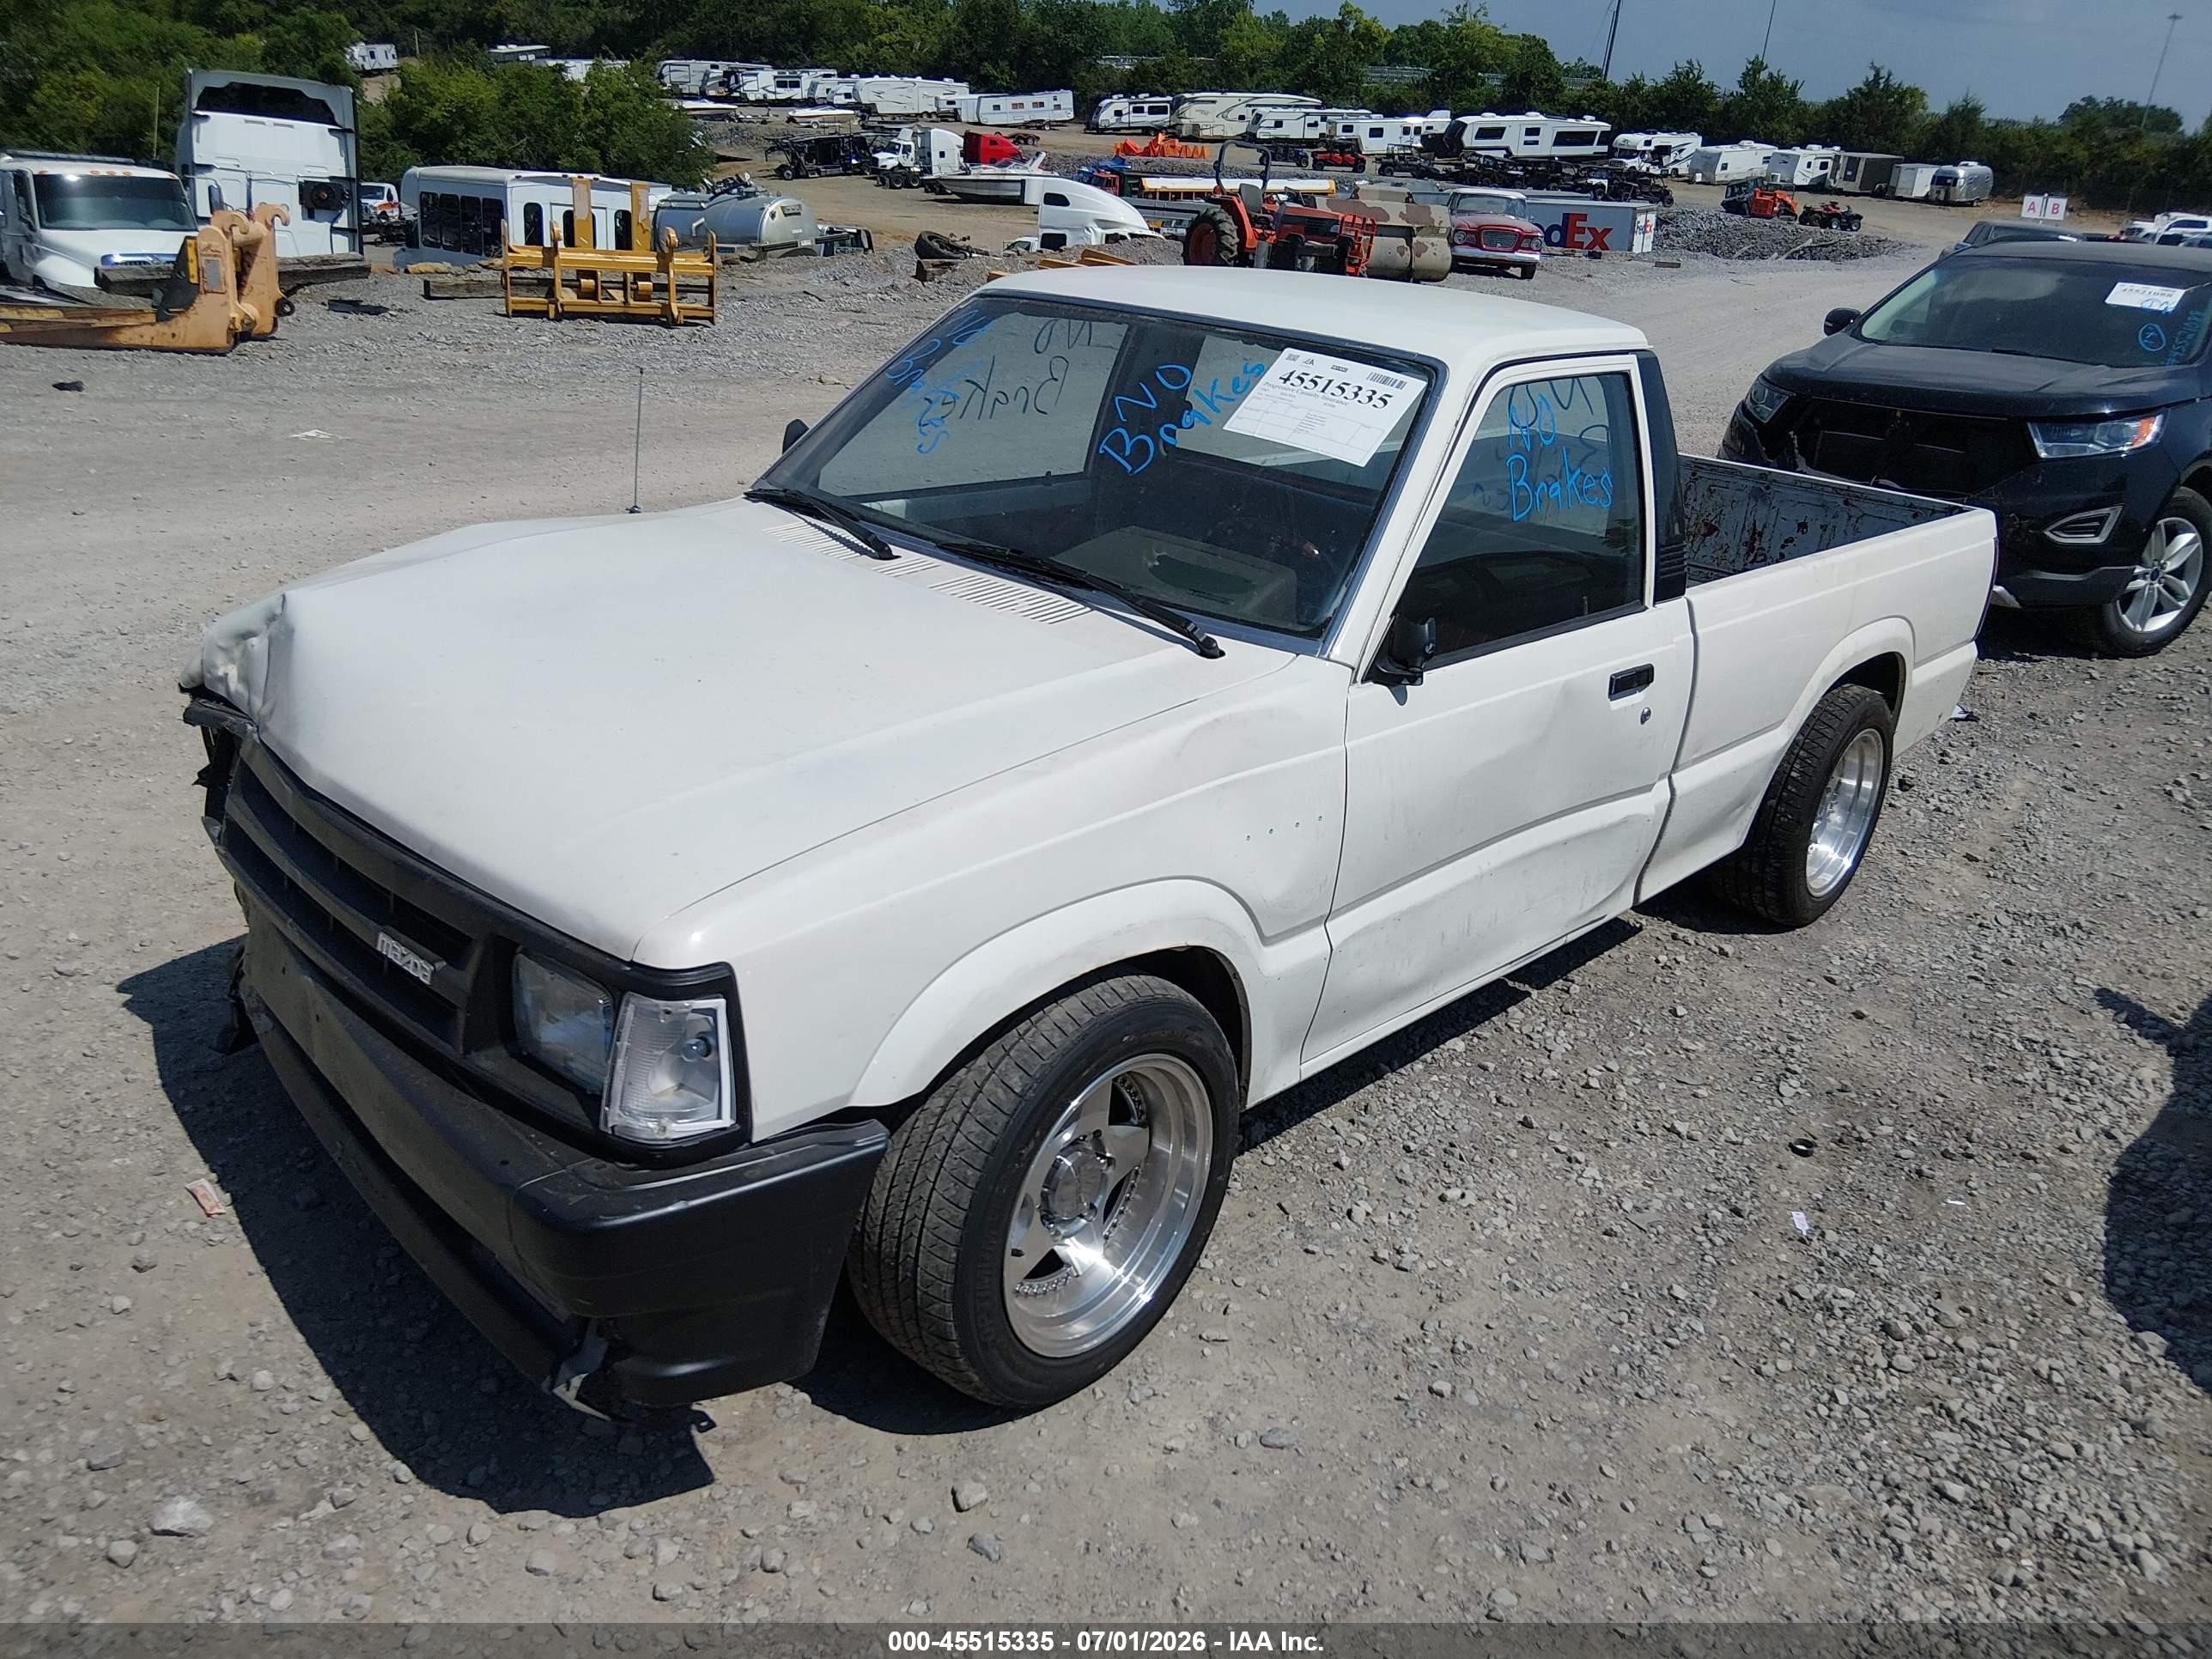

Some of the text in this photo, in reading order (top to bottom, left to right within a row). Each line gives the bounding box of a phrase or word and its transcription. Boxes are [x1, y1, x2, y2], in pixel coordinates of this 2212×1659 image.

[2027, 201, 2036, 213] A
[2051, 203, 2060, 215] B
[1533, 212, 1613, 250] dEx
[1115, 364, 1193, 422] NO
[1279, 369, 1393, 409] 45515335
[1508, 392, 1557, 453] NO
[1505, 446, 1614, 523] Brakes
